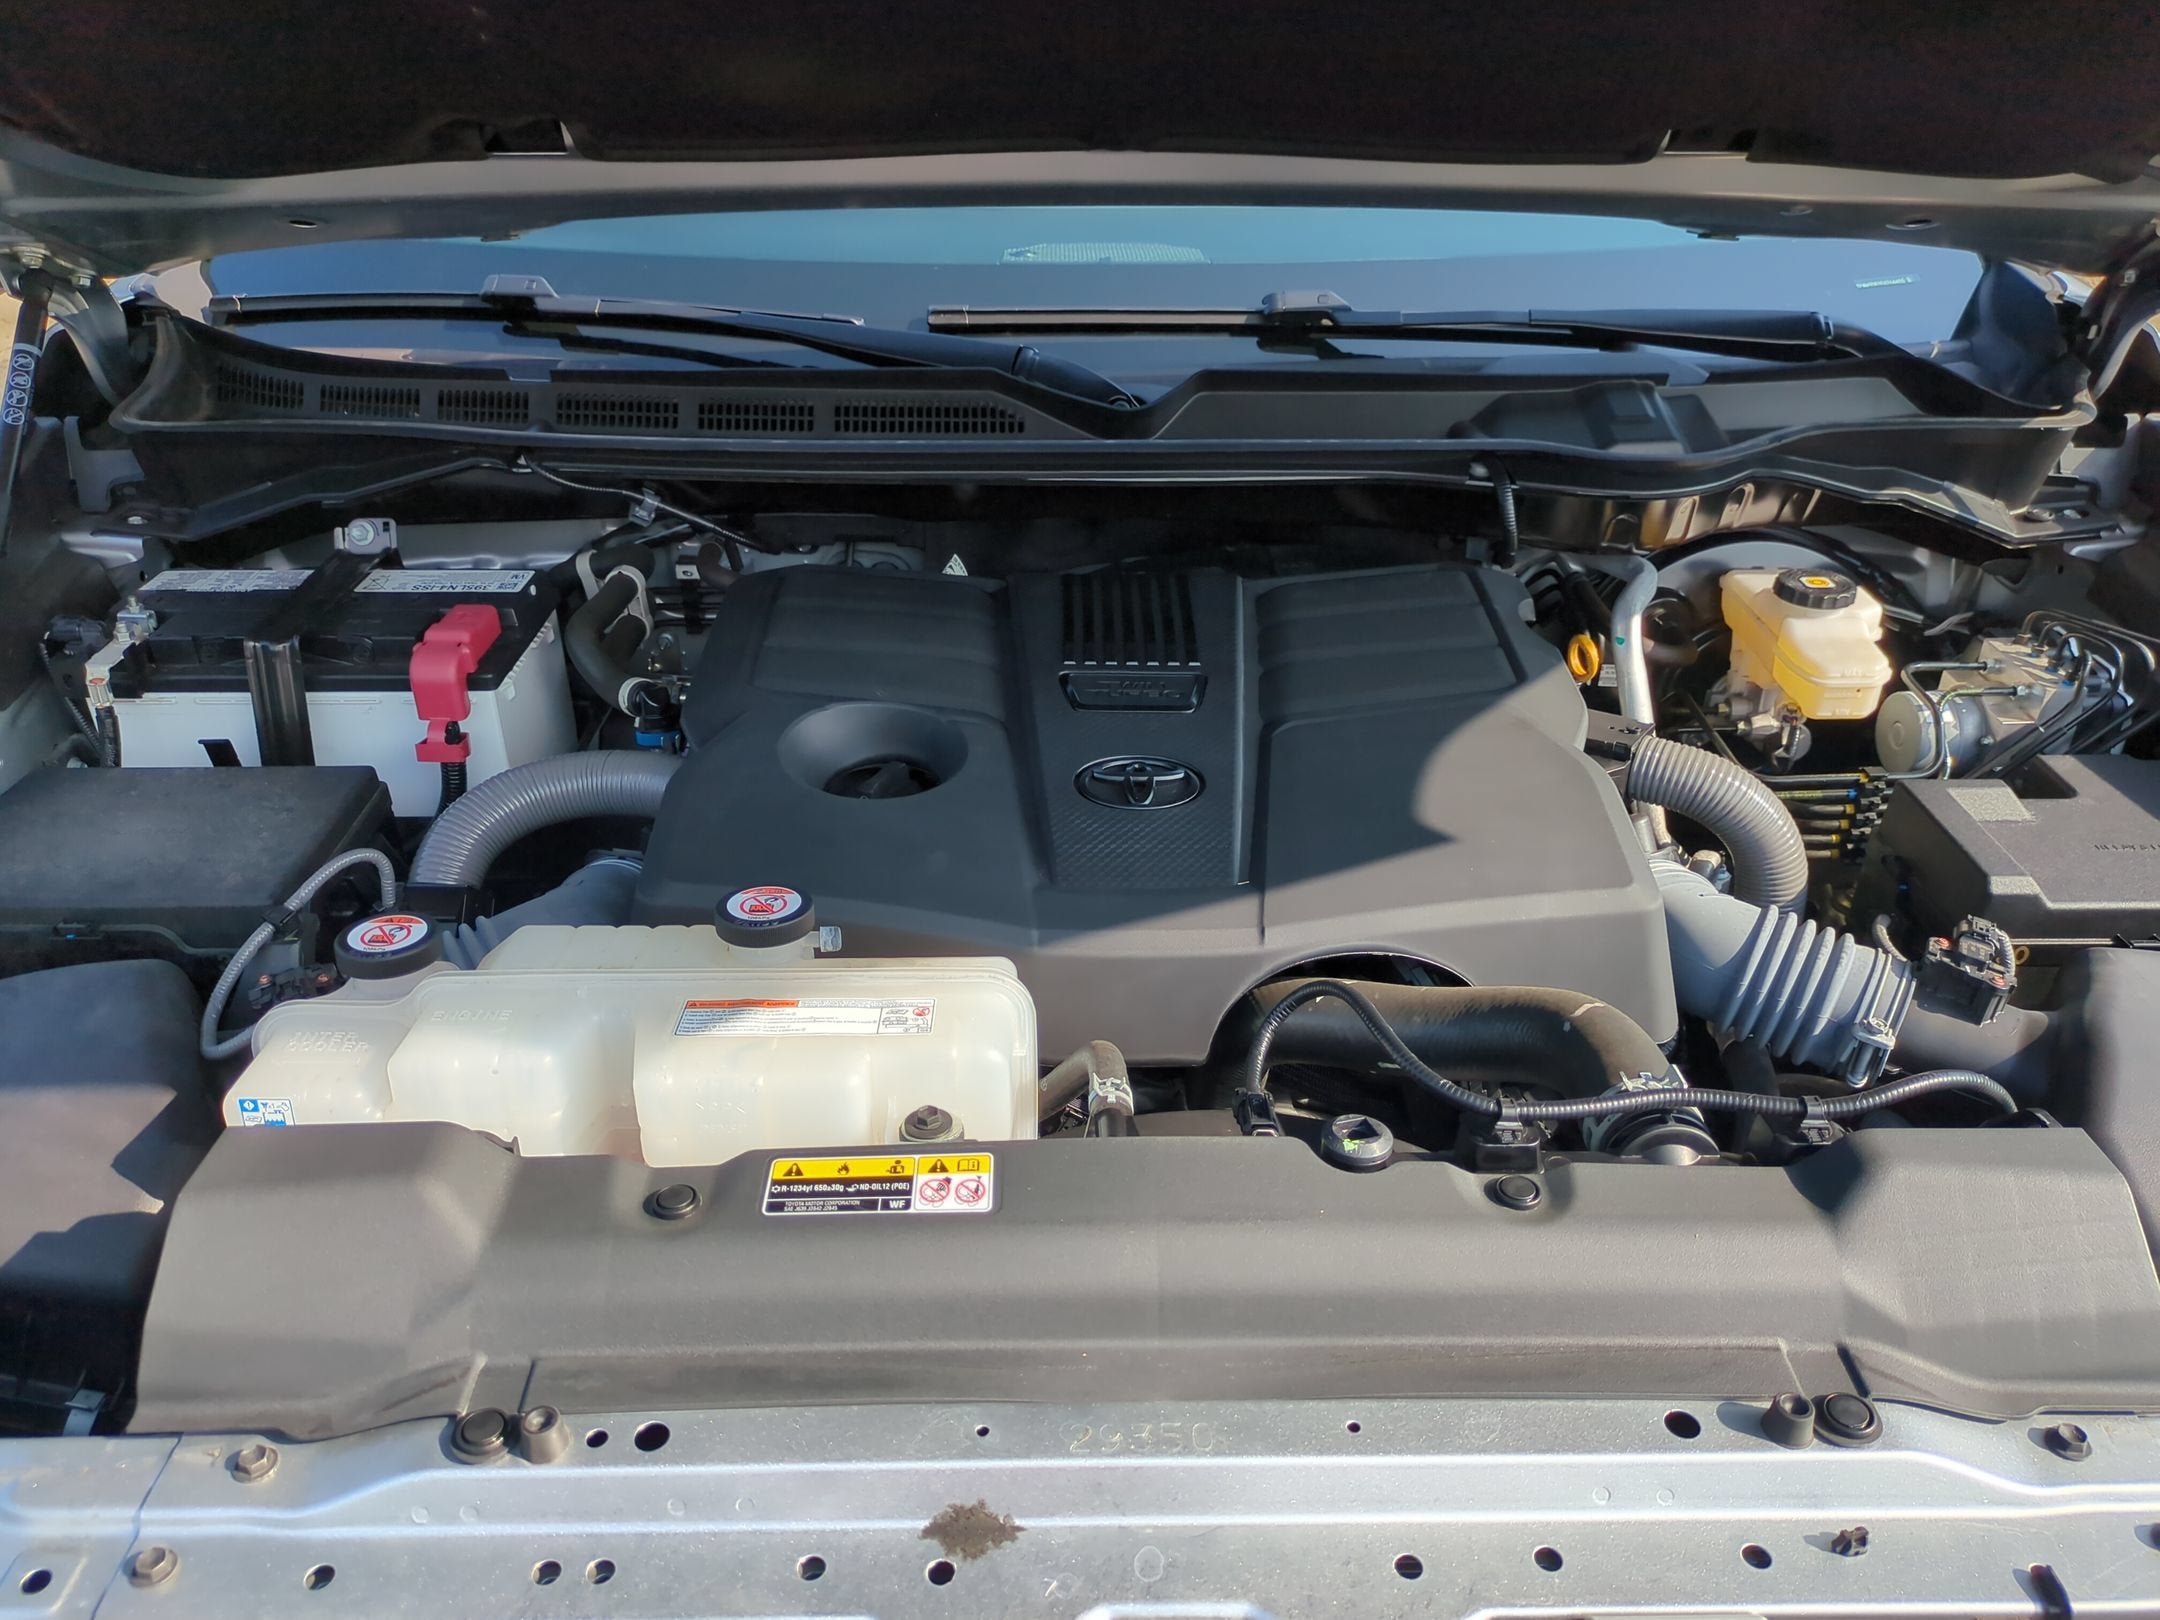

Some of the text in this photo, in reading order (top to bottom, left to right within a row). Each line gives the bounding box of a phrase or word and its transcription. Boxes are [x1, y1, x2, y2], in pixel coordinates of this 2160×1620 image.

[781, 1184, 813, 1193] R-1234yf
[891, 1181, 910, 1191] (POE)
[889, 1200, 906, 1209] WF
